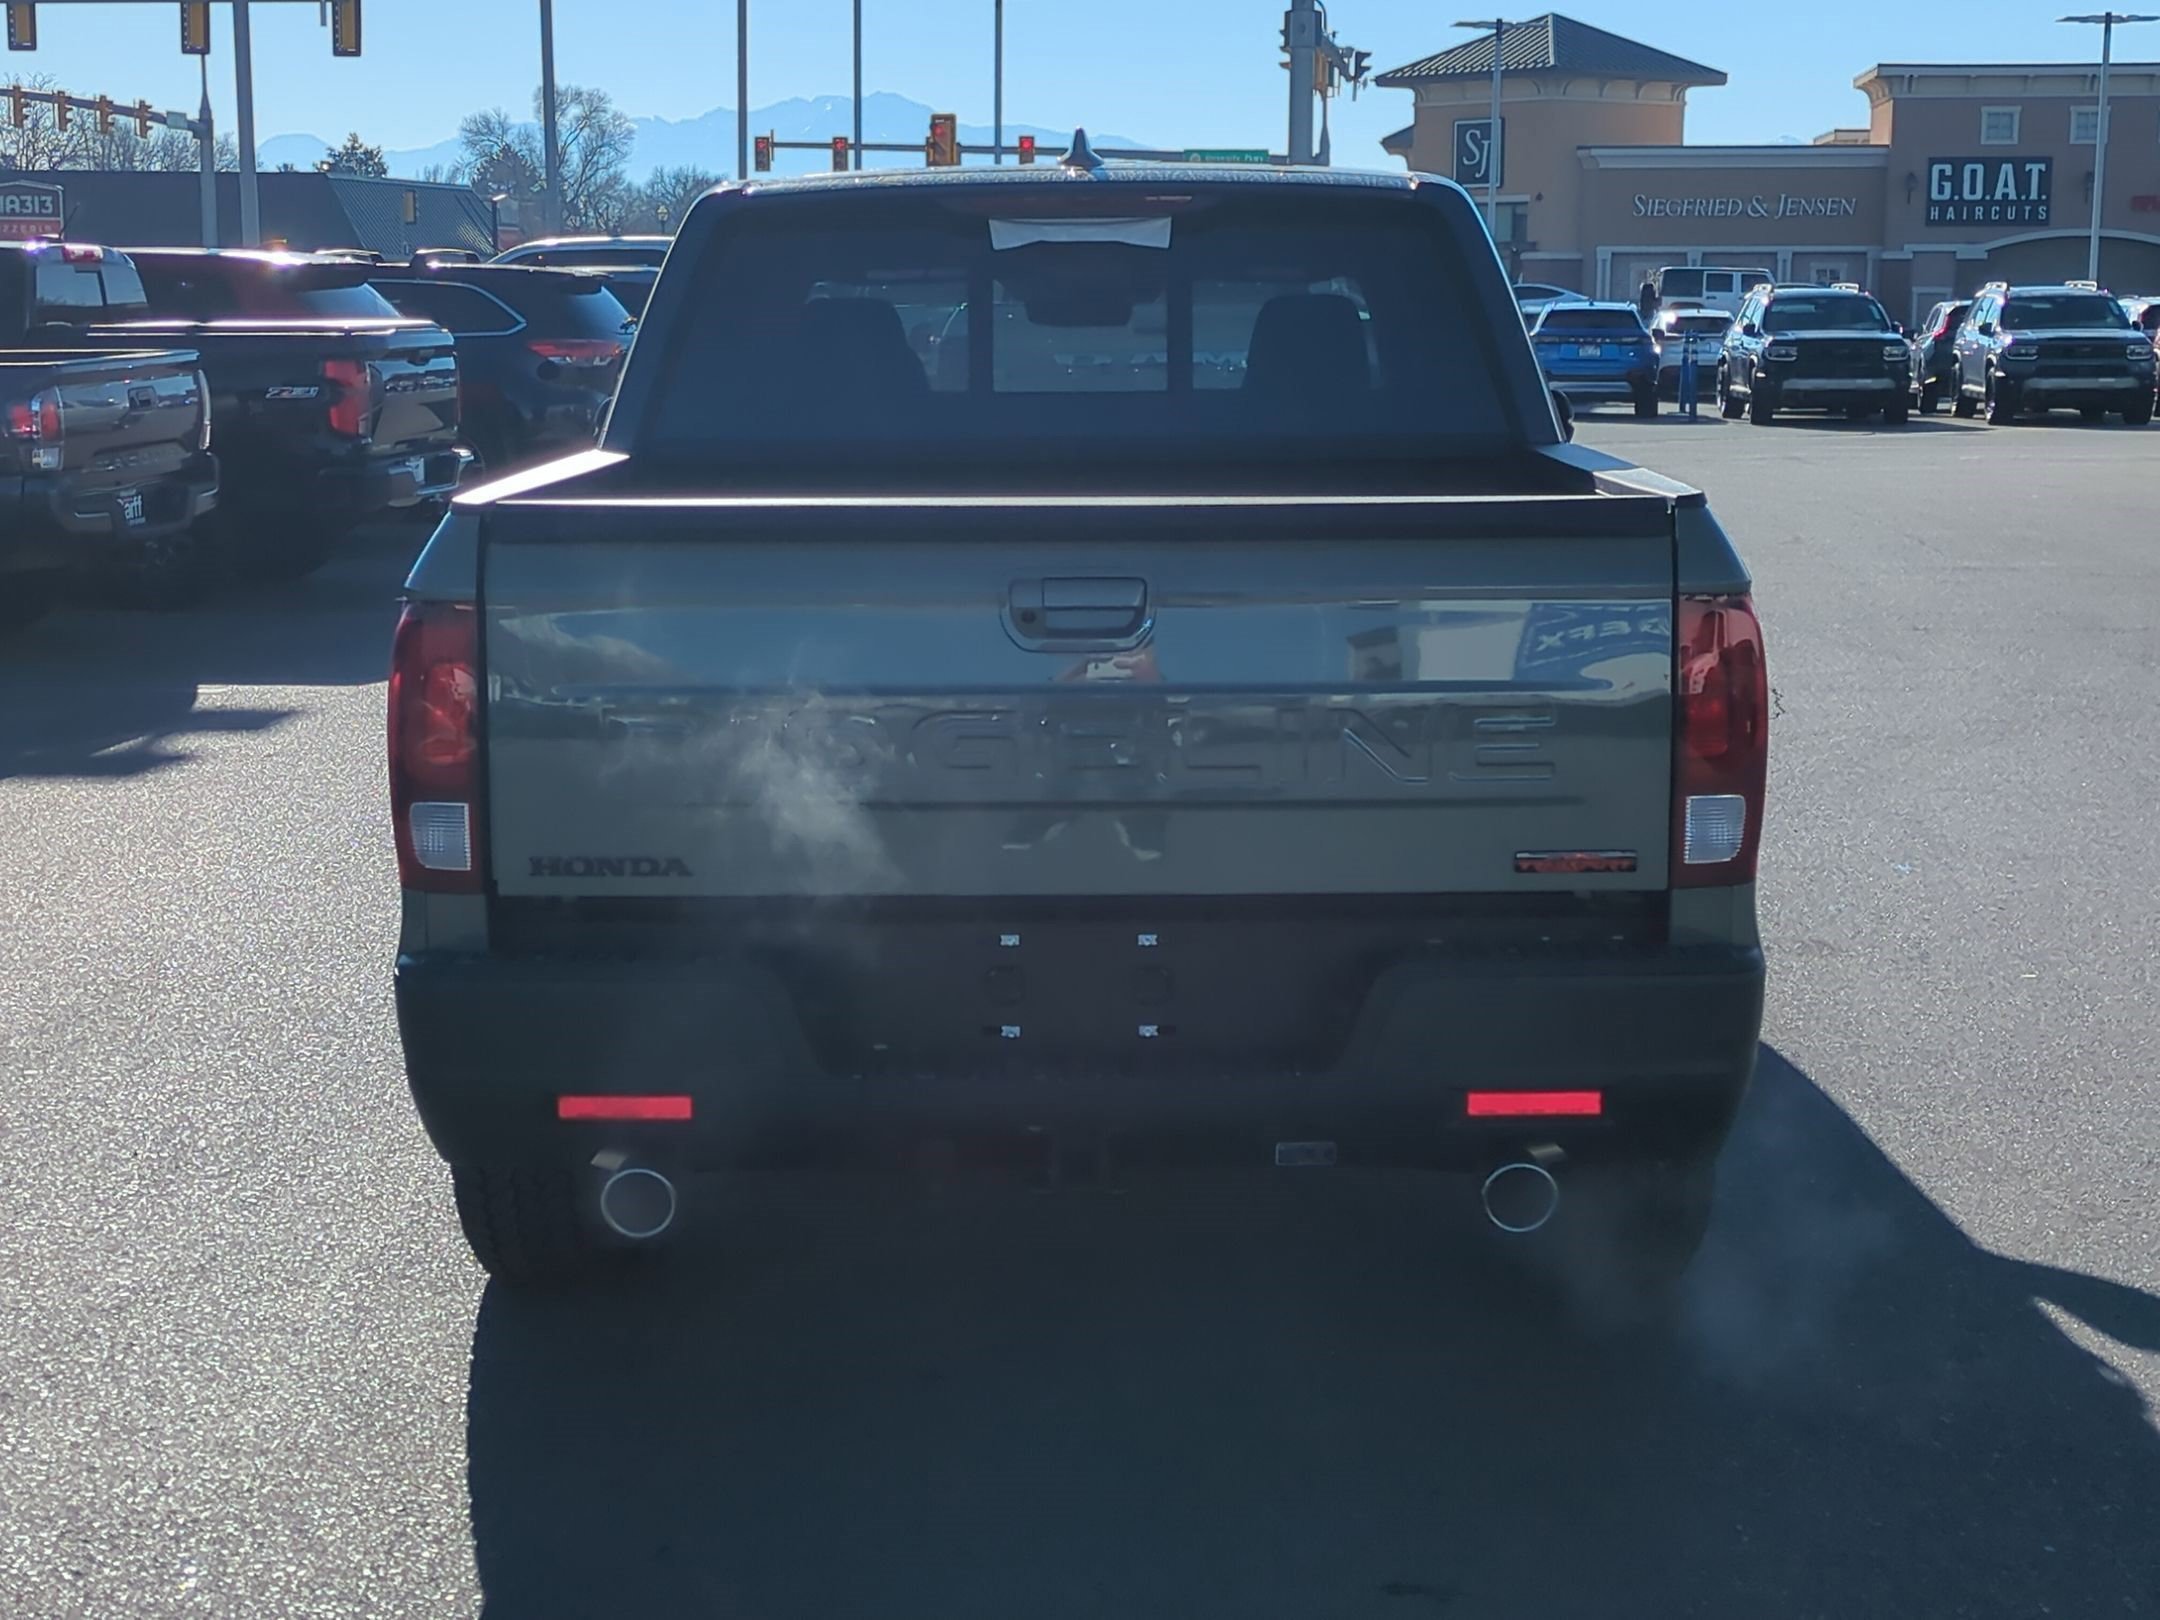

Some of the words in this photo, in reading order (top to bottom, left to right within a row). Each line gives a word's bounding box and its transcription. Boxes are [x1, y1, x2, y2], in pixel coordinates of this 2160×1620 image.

[1462, 129, 1492, 179] SJ
[1930, 162, 2047, 201] G.O.A.T.
[1632, 194, 1743, 217] SIEGFRIED
[1747, 195, 1768, 217] &
[1774, 193, 1857, 220] JENSEN
[1929, 205, 2048, 221] HAIRCUTS
[600, 707, 1558, 785] DGELINE
[528, 856, 696, 877] HONDA
